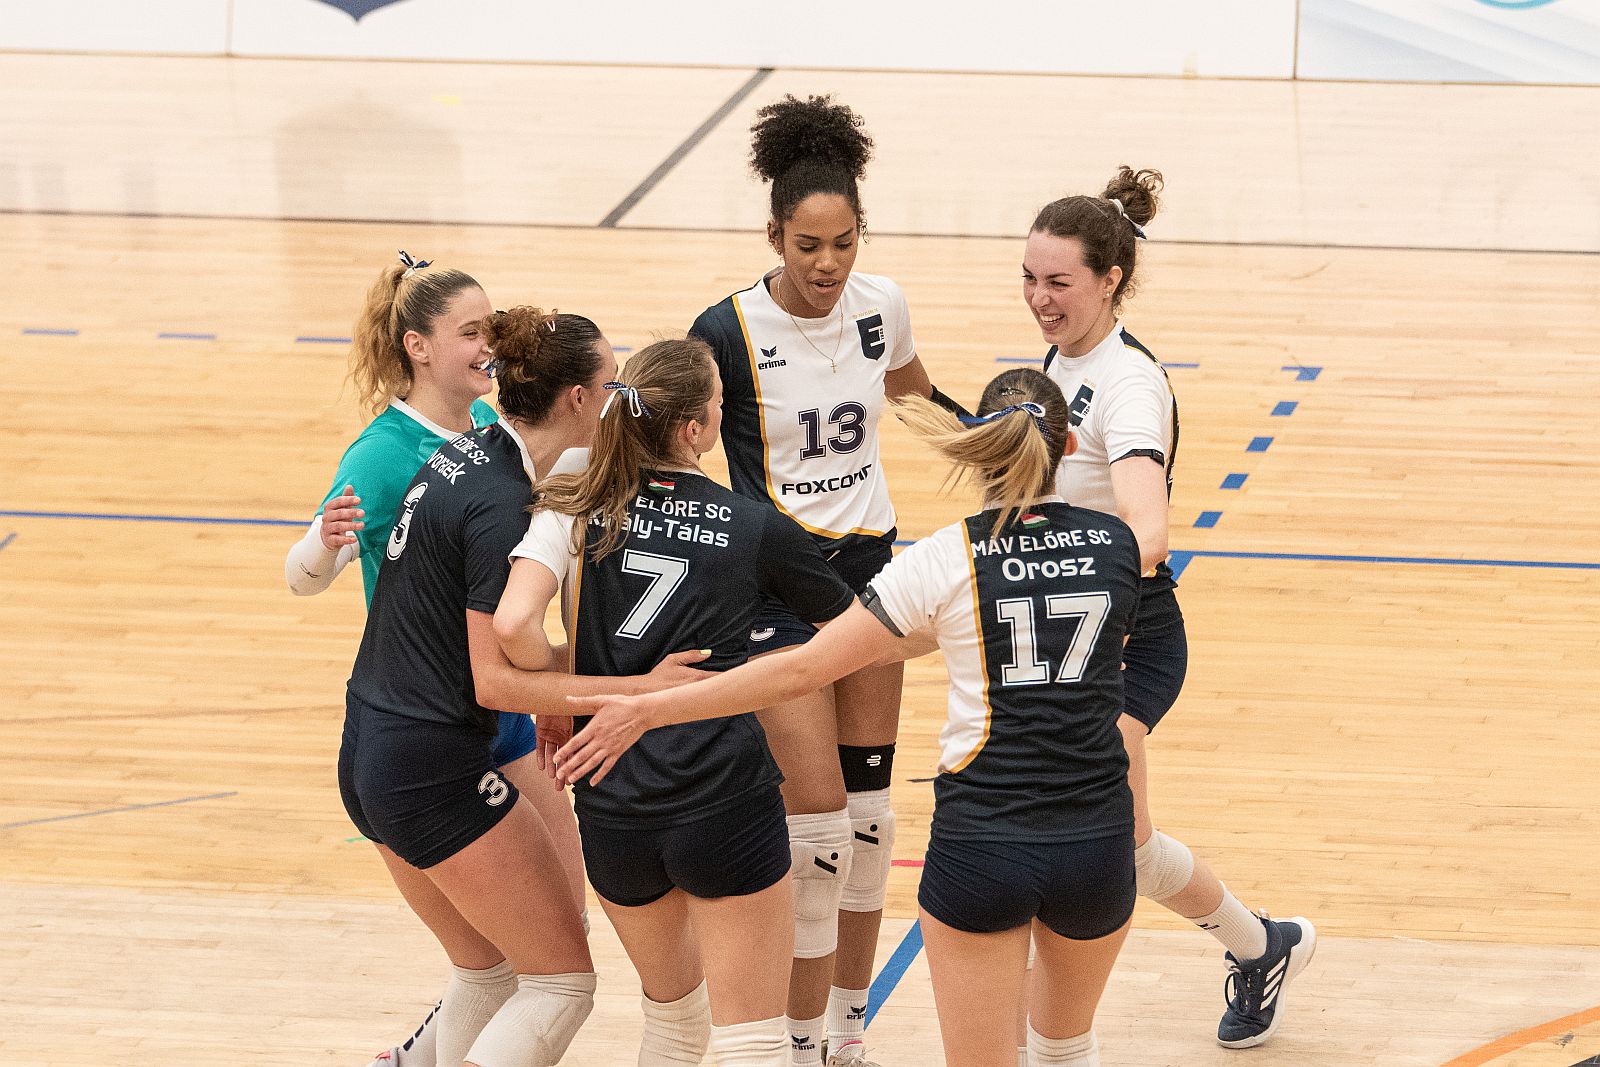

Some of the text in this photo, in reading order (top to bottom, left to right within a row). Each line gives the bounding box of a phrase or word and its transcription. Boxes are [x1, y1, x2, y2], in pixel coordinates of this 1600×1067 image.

[758, 359, 787, 370] erima
[798, 401, 867, 461] 13
[467, 450, 490, 465] SC
[386, 482, 429, 561] 3
[635, 495, 732, 522] ELŐRE SC
[1087, 529, 1113, 546] SC
[1001, 557, 1097, 582] Orosz
[614, 548, 690, 640] 7
[995, 591, 1112, 687] 17
[477, 770, 509, 807] 3
